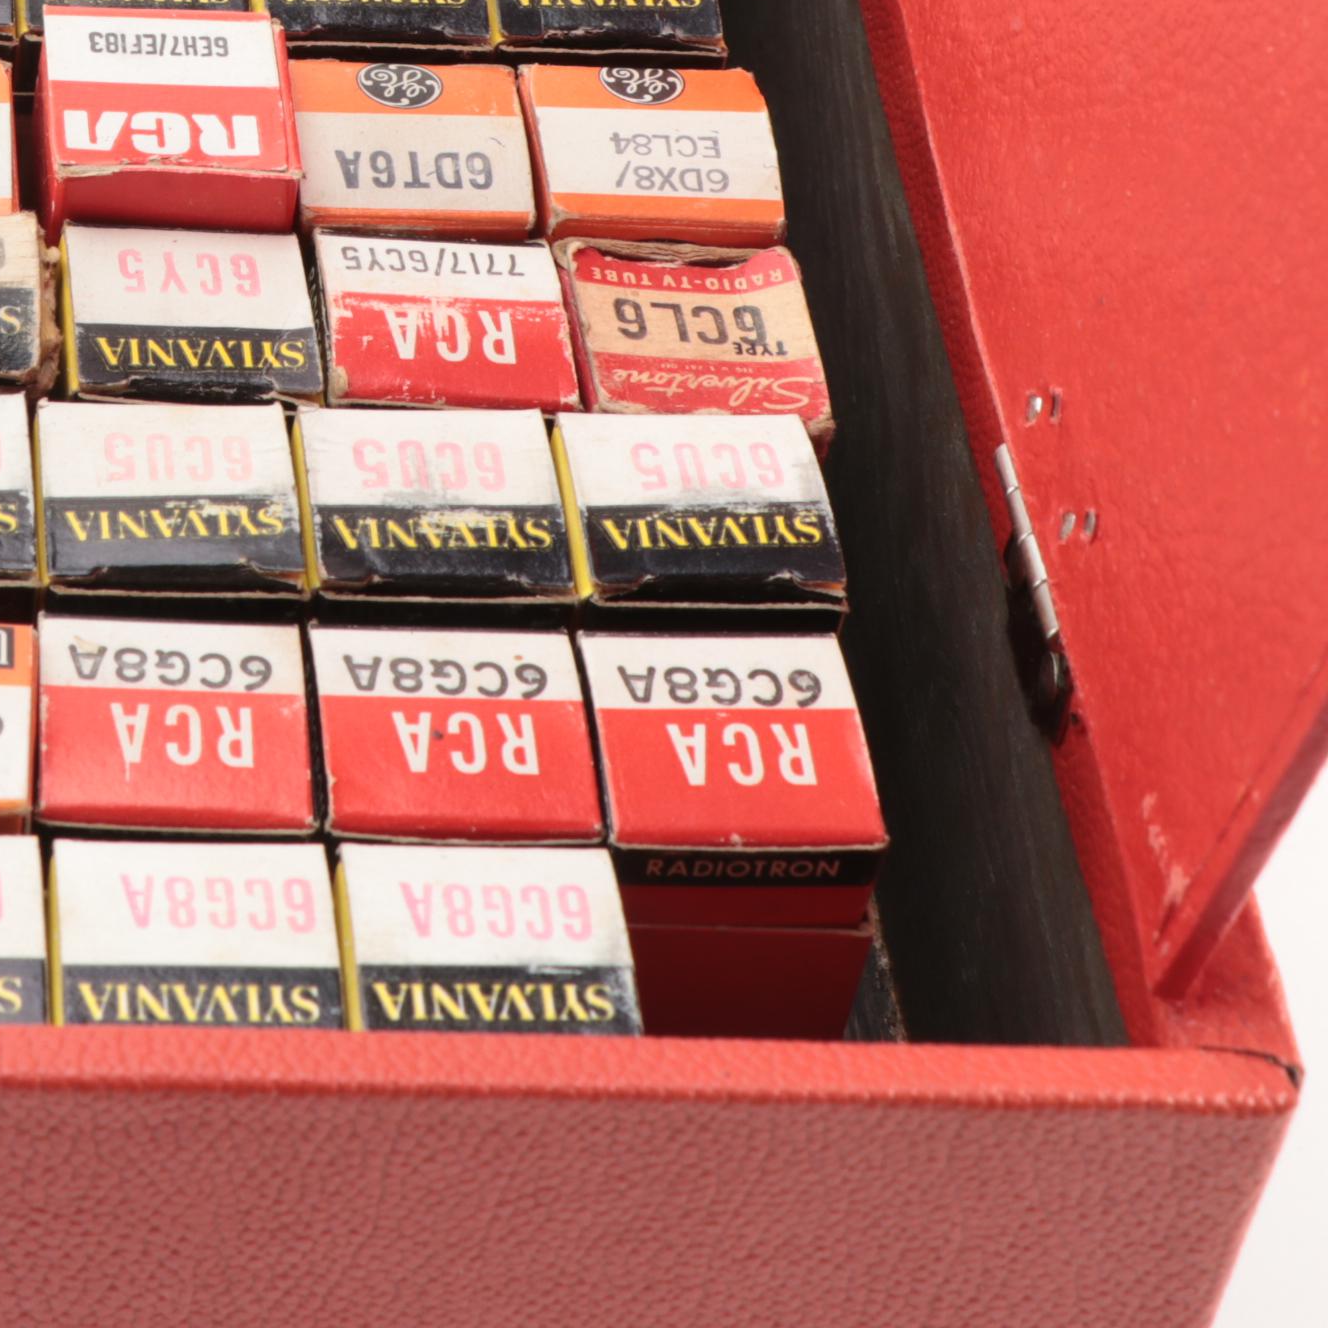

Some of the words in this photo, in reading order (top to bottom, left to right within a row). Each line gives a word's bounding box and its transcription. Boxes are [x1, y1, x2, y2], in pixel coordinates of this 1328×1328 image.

[62, 108, 263, 157] RCA
[609, 131, 723, 160] ECL84
[333, 149, 495, 192] 6DT6A
[613, 161, 732, 194] 6DX8/
[116, 249, 263, 299] 6CY5
[339, 246, 527, 278] 7717/6CY5
[589, 266, 654, 287] TUBE
[660, 269, 785, 293] RADIO-TV
[383, 309, 518, 366] RCA
[612, 297, 769, 348] 6CL6
[94, 336, 307, 370] SYLVANIA
[731, 340, 790, 357] TYPE
[611, 367, 816, 411] Silvertone
[350, 437, 508, 493] 6CU5
[628, 441, 786, 492] 6CU5
[332, 517, 554, 551] SYLVANIA
[600, 515, 824, 551] SYLVANIA
[67, 644, 274, 692] 6CG8A
[342, 654, 550, 701] 6CG8A
[616, 665, 824, 709] 6CG8A
[108, 702, 256, 770] RCA
[391, 710, 542, 777] RCA
[665, 722, 819, 788] RCA
[645, 856, 842, 880] RADIOTRON
[397, 880, 596, 944] 6CG8A
[372, 981, 617, 1023] SYLVANIA
